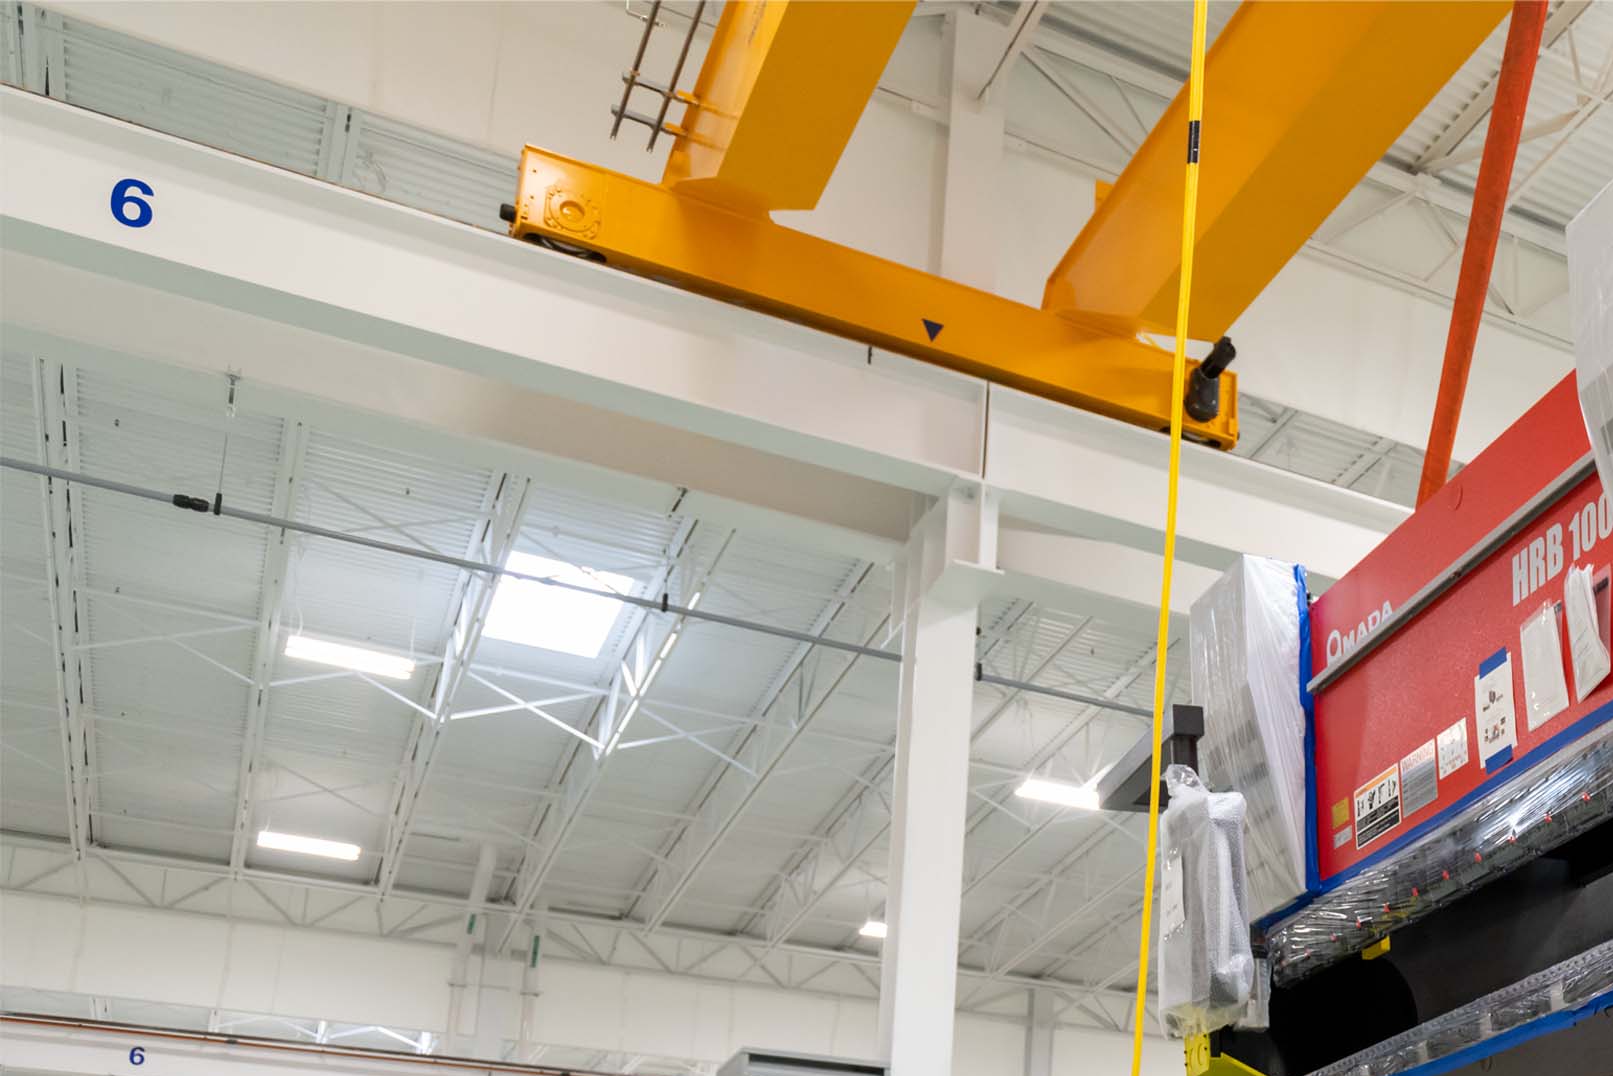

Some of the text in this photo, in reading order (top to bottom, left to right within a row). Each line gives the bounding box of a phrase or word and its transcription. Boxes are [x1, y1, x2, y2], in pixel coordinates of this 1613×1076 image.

[110, 178, 155, 229] 6
[1511, 522, 1564, 608] HRB
[1326, 600, 1393, 668] AMADA
[129, 1046, 145, 1066] 6
